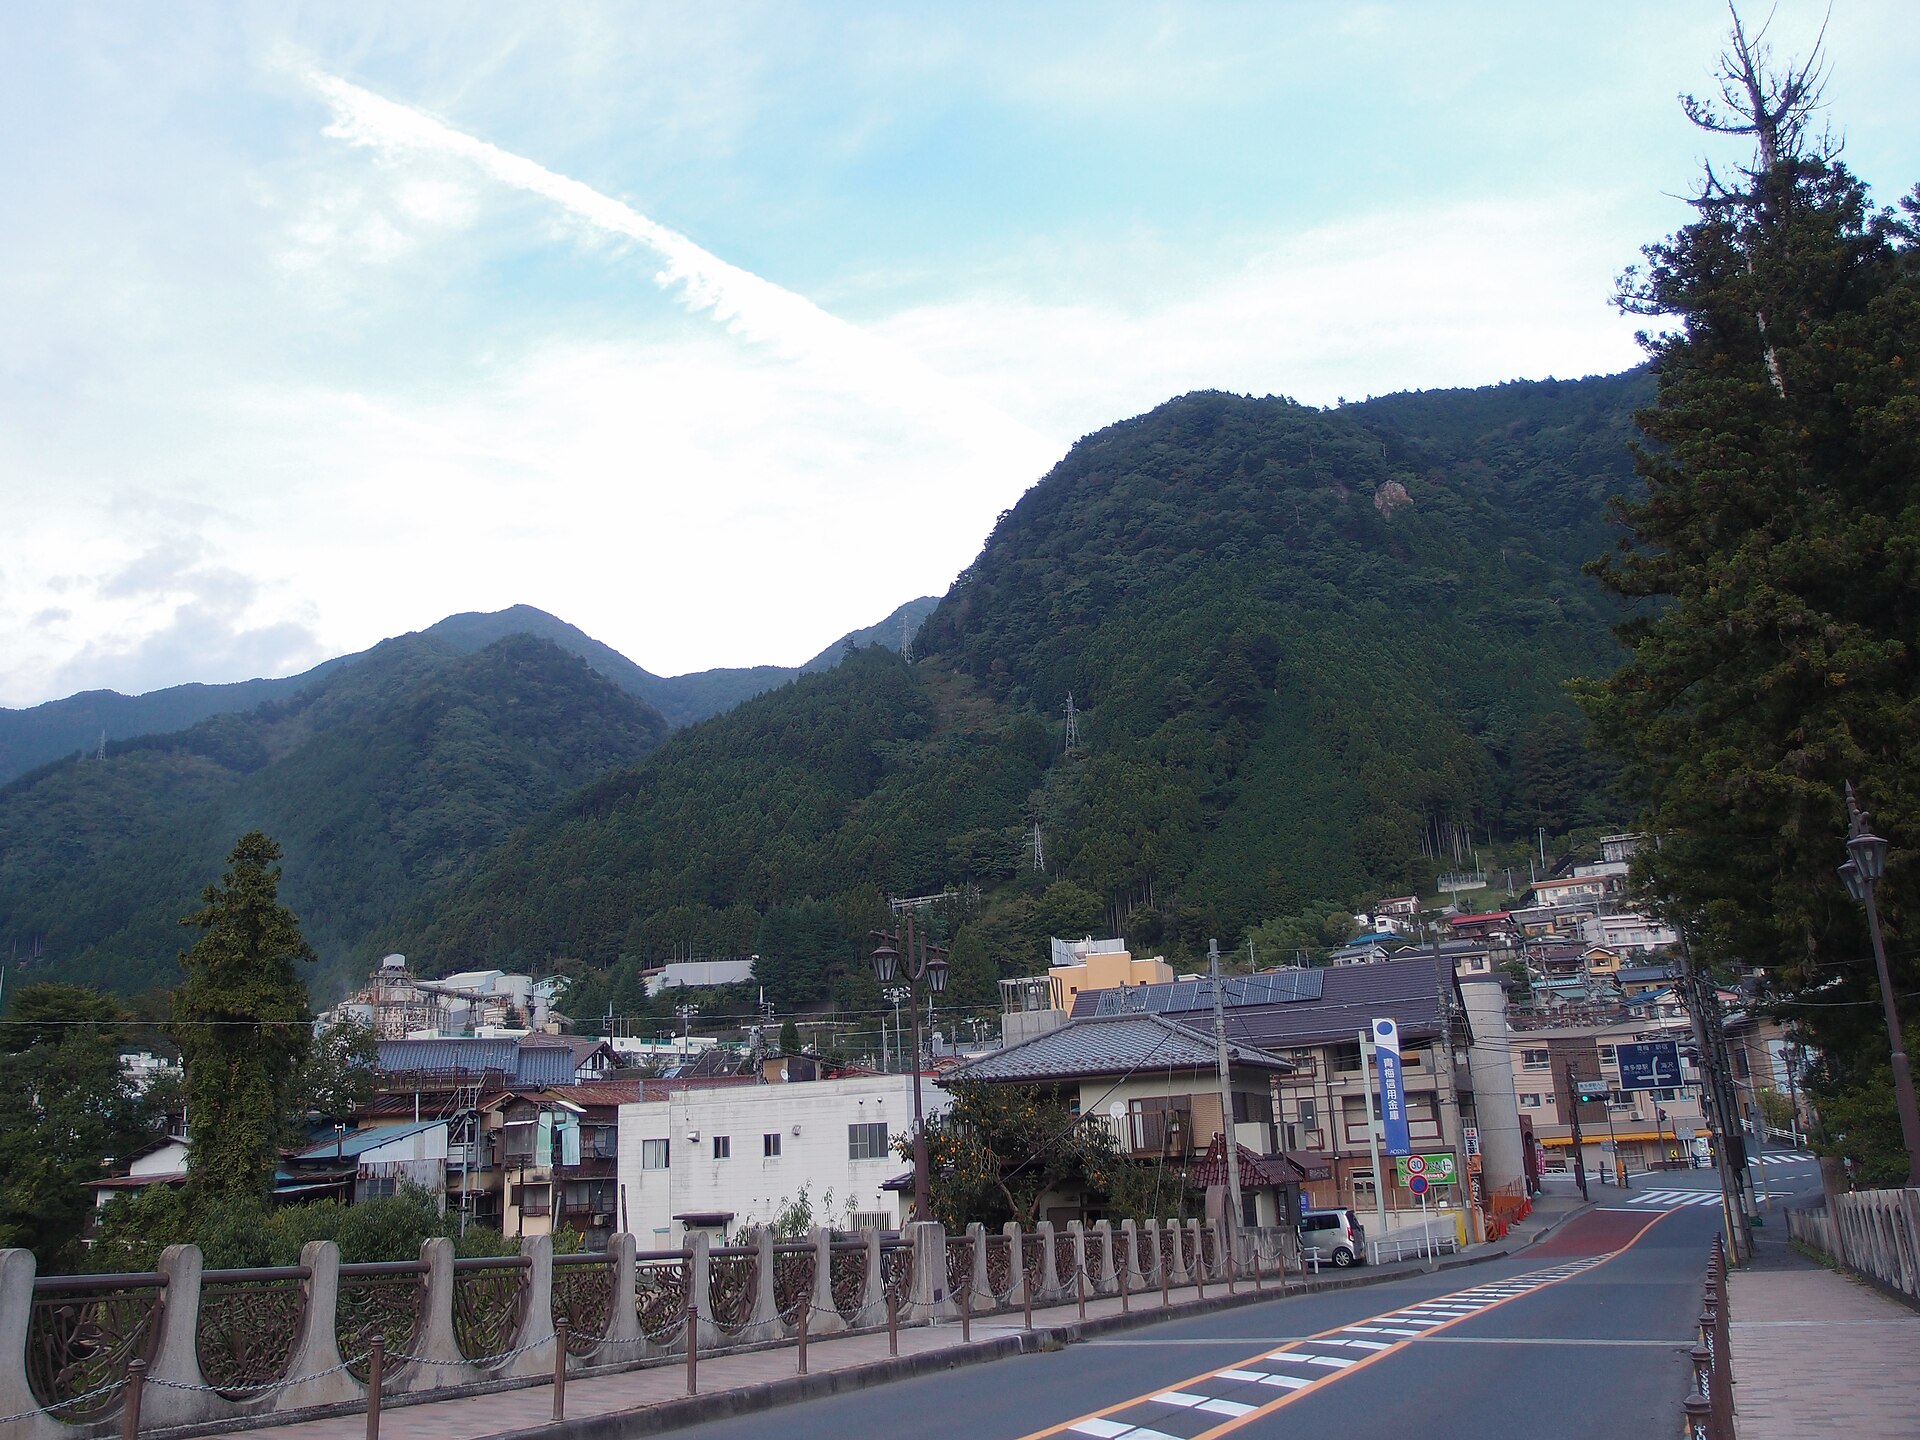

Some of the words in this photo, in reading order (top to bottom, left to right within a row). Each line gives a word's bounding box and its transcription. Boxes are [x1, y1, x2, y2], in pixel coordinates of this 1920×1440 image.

[1383, 1058, 1400, 1120] 青梅信用金庫
[1410, 1160, 1422, 1170] 30
